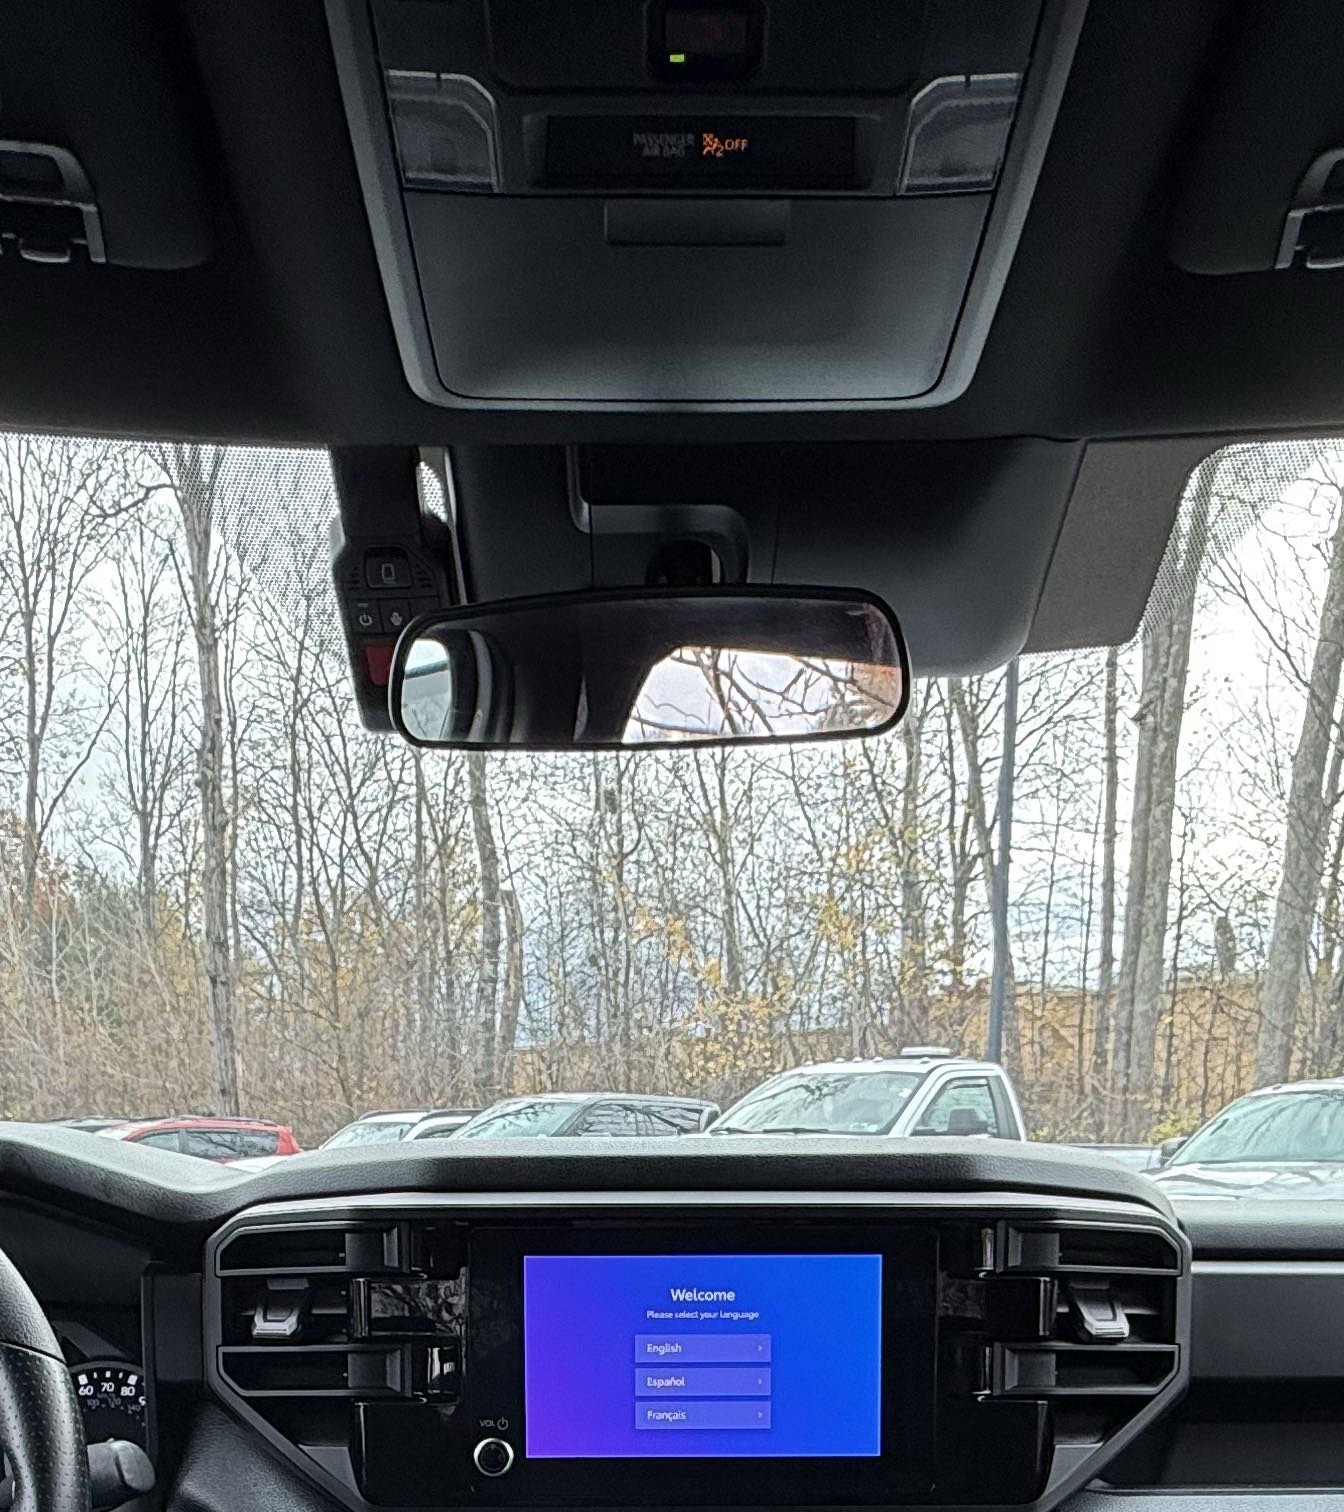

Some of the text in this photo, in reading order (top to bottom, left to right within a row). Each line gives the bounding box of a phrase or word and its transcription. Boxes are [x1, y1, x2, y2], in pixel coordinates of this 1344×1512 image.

[725, 139, 748, 151] OFF
[670, 1288, 736, 1302] Welcome
[646, 1310, 759, 1320] Please select your language
[646, 1344, 682, 1356] English
[100, 1382, 115, 1393] 70
[646, 1377, 686, 1389] Español
[78, 1385, 94, 1396] 60
[120, 1386, 135, 1396] 80
[647, 1410, 687, 1422] Français
